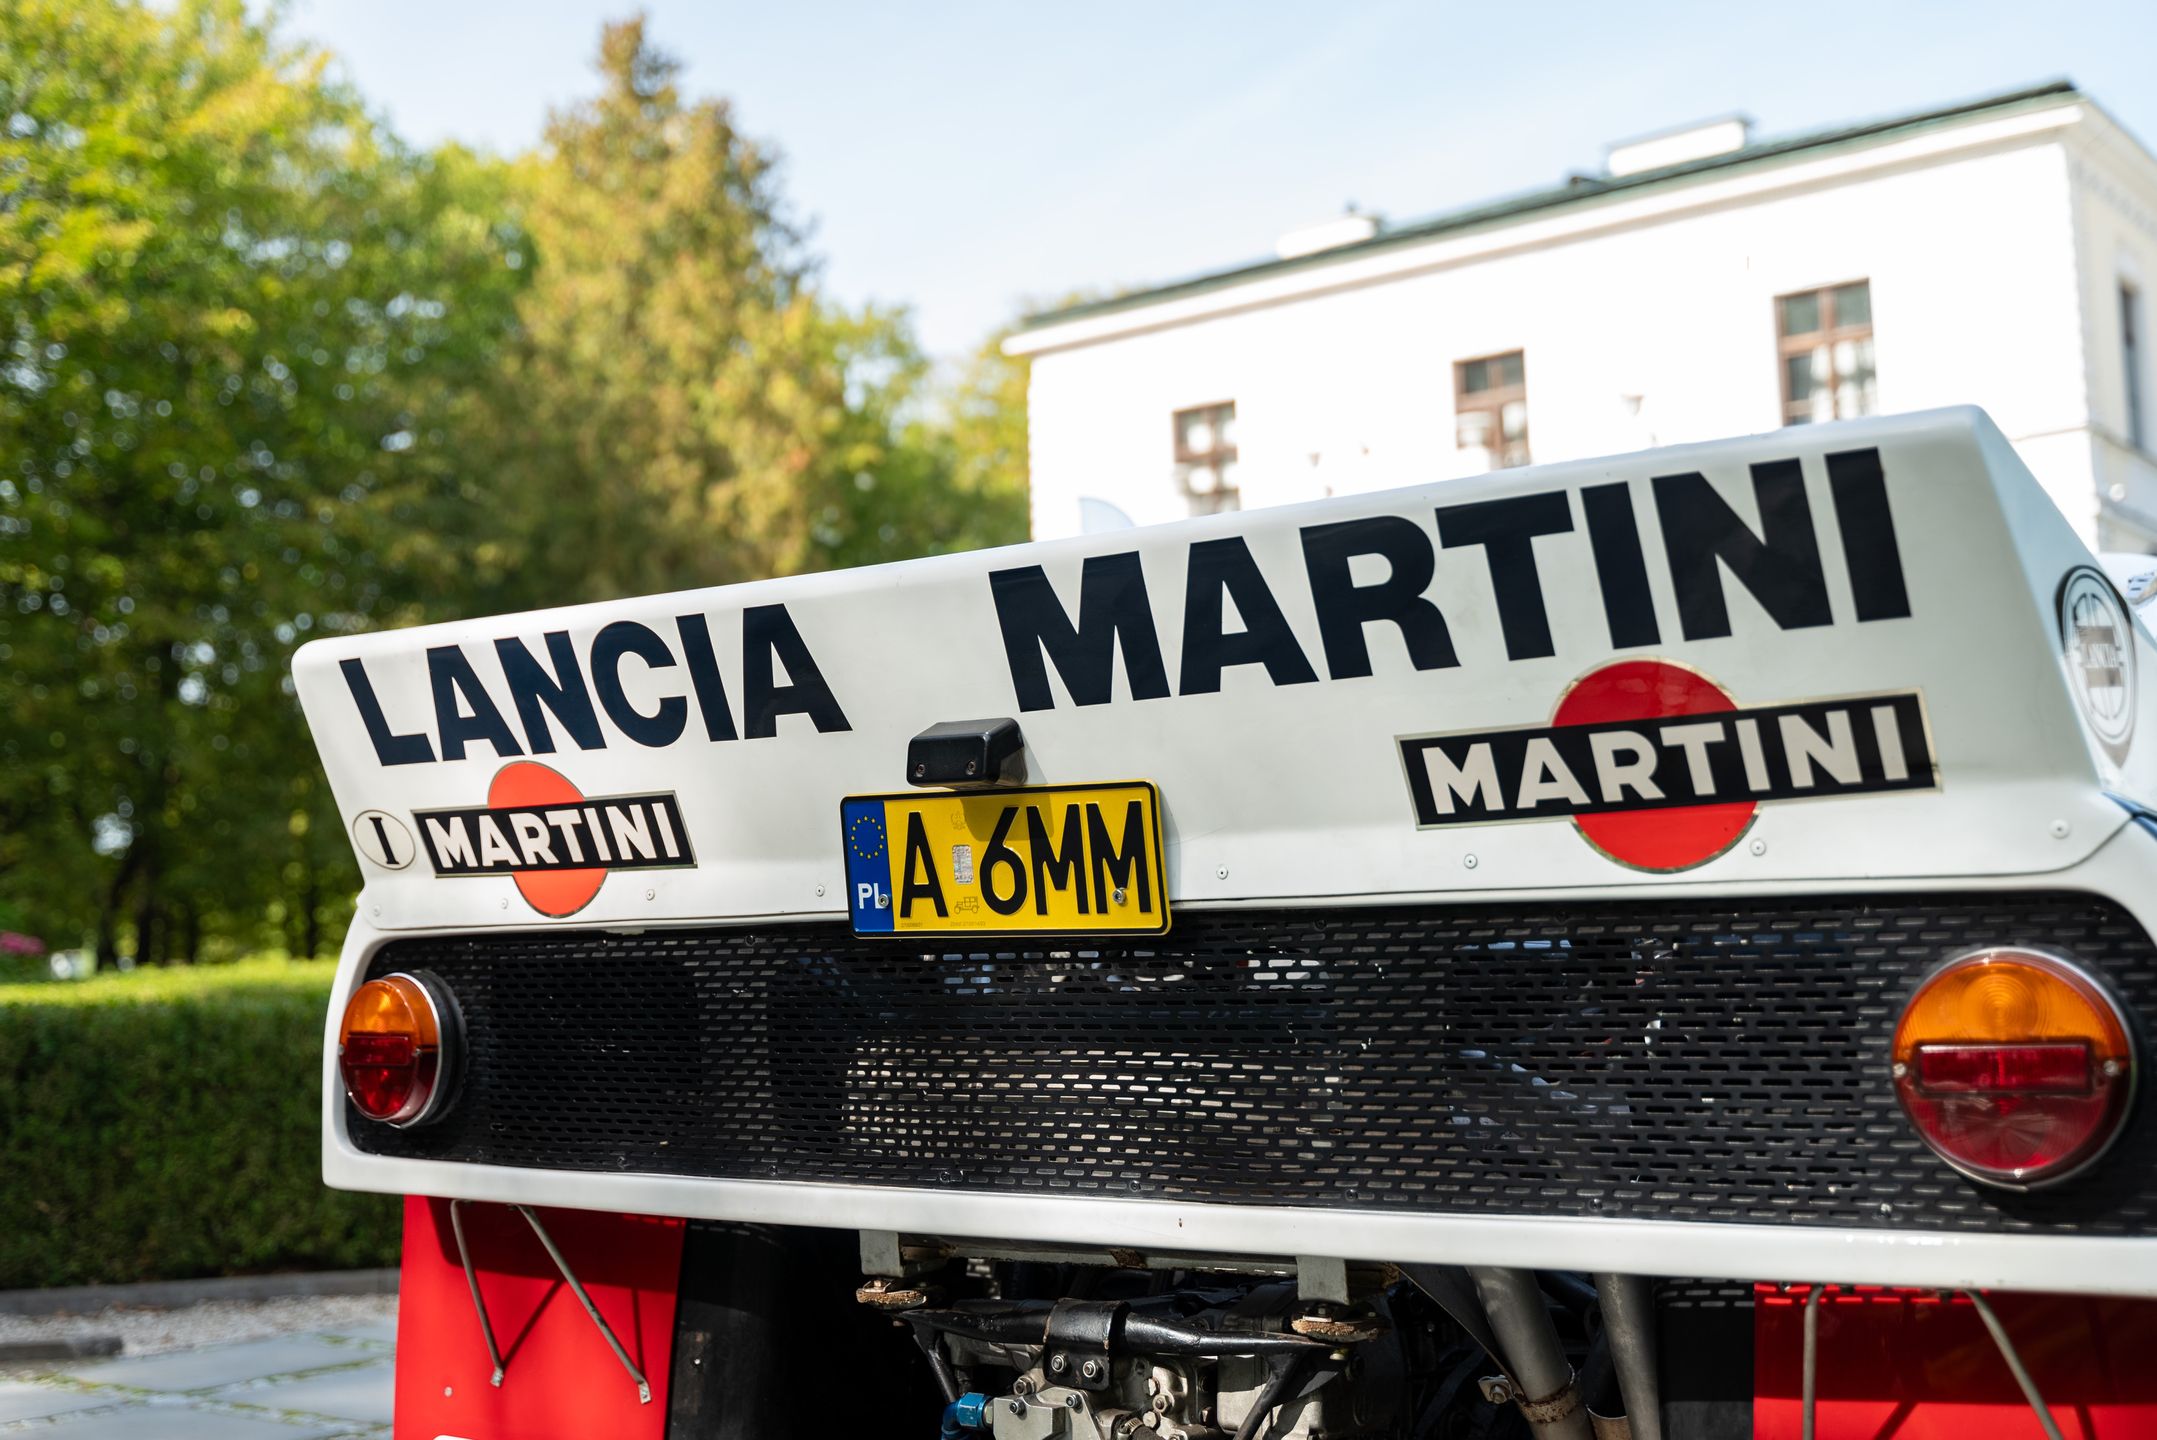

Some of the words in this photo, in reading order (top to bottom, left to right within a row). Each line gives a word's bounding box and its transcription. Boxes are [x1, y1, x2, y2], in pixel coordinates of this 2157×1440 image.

[339, 603, 852, 766] LANCIA
[988, 447, 1910, 712] MARTINI
[1422, 706, 1909, 816] MARTINI
[368, 816, 400, 866] I
[425, 802, 681, 868] MARTINI
[857, 882, 886, 909] PL
